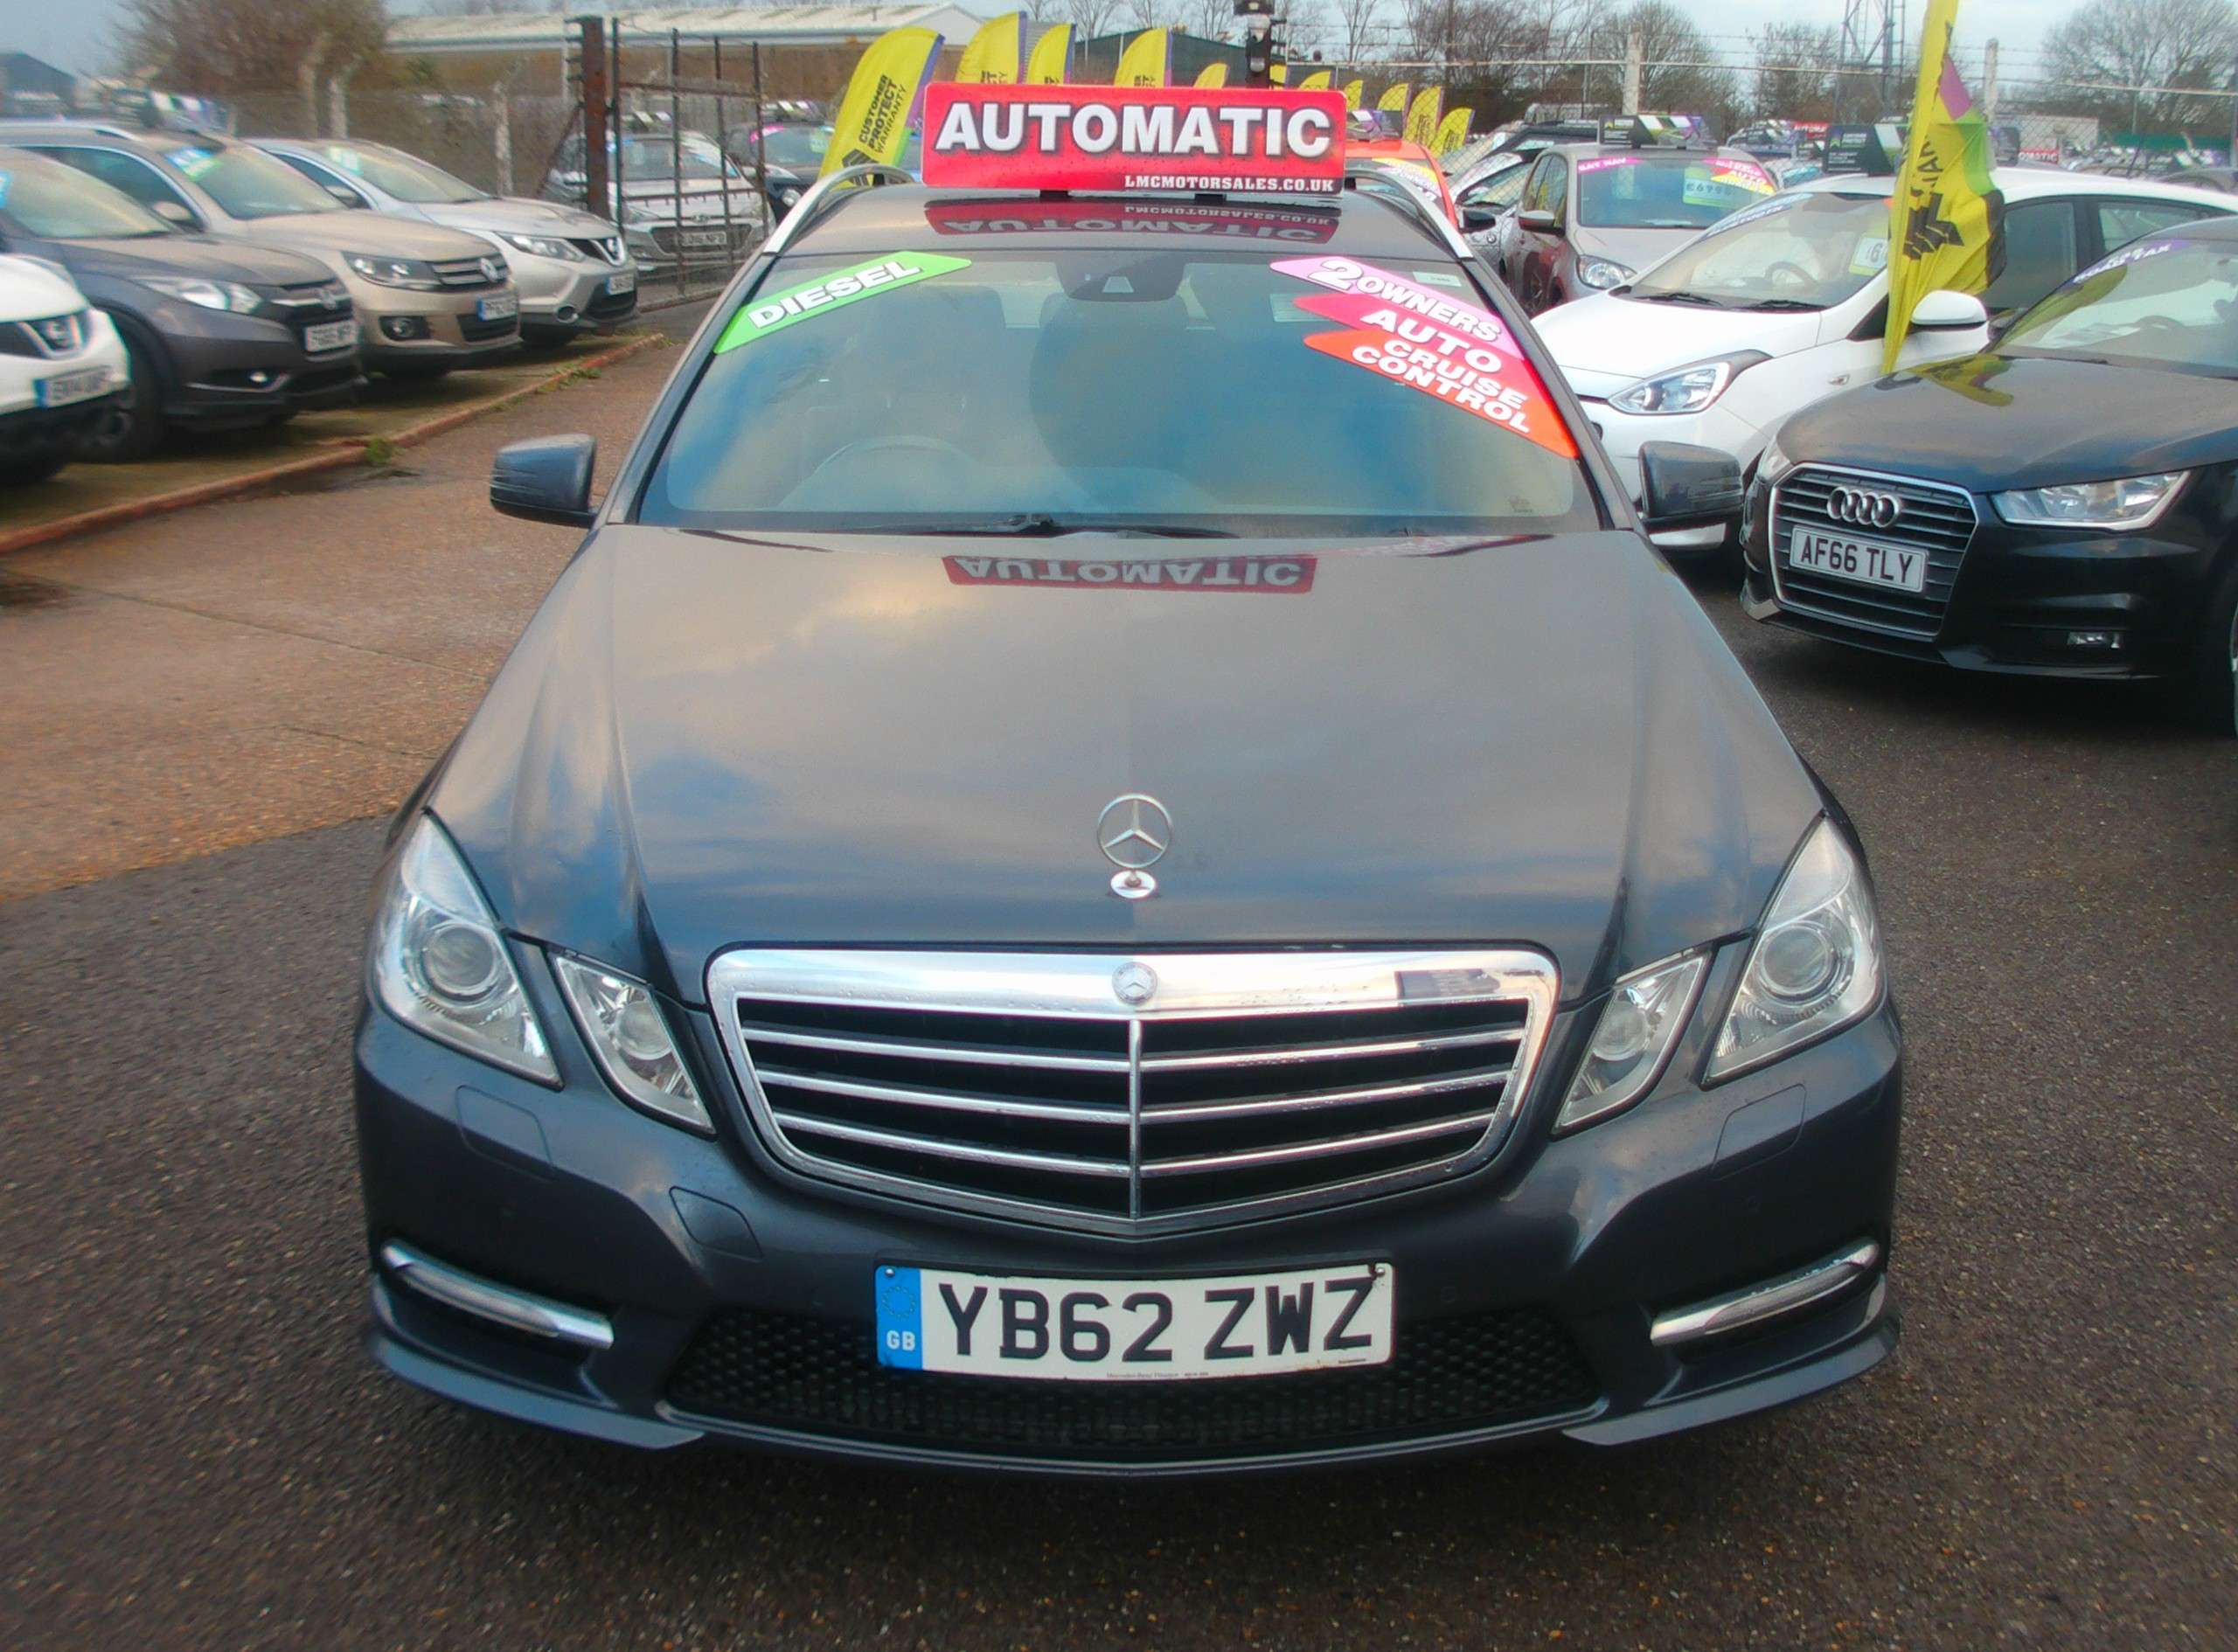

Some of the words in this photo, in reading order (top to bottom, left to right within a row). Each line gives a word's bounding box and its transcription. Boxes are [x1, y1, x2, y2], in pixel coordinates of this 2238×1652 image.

[858, 74, 888, 143] CUSTOMER
[867, 79, 897, 149] PROTECT
[874, 84, 907, 154] WARRANTY
[935, 102, 1331, 159] AUTOMATIC
[1124, 175, 1334, 192] LMCMOTORSALES.CO.UK
[747, 261, 922, 329] DIESEL
[1308, 260, 1364, 291] 2
[1356, 279, 1502, 342] OWNERS
[1360, 309, 1502, 373] AUTO
[1384, 340, 1528, 411] CRUISE
[1352, 345, 1530, 434] CONTROL
[1801, 535, 1858, 573] AF66
[1866, 546, 1913, 584] TLY
[886, 1329, 915, 1351] GB
[938, 1282, 1173, 1363] YB62
[1204, 1276, 1374, 1360] ZWZ
